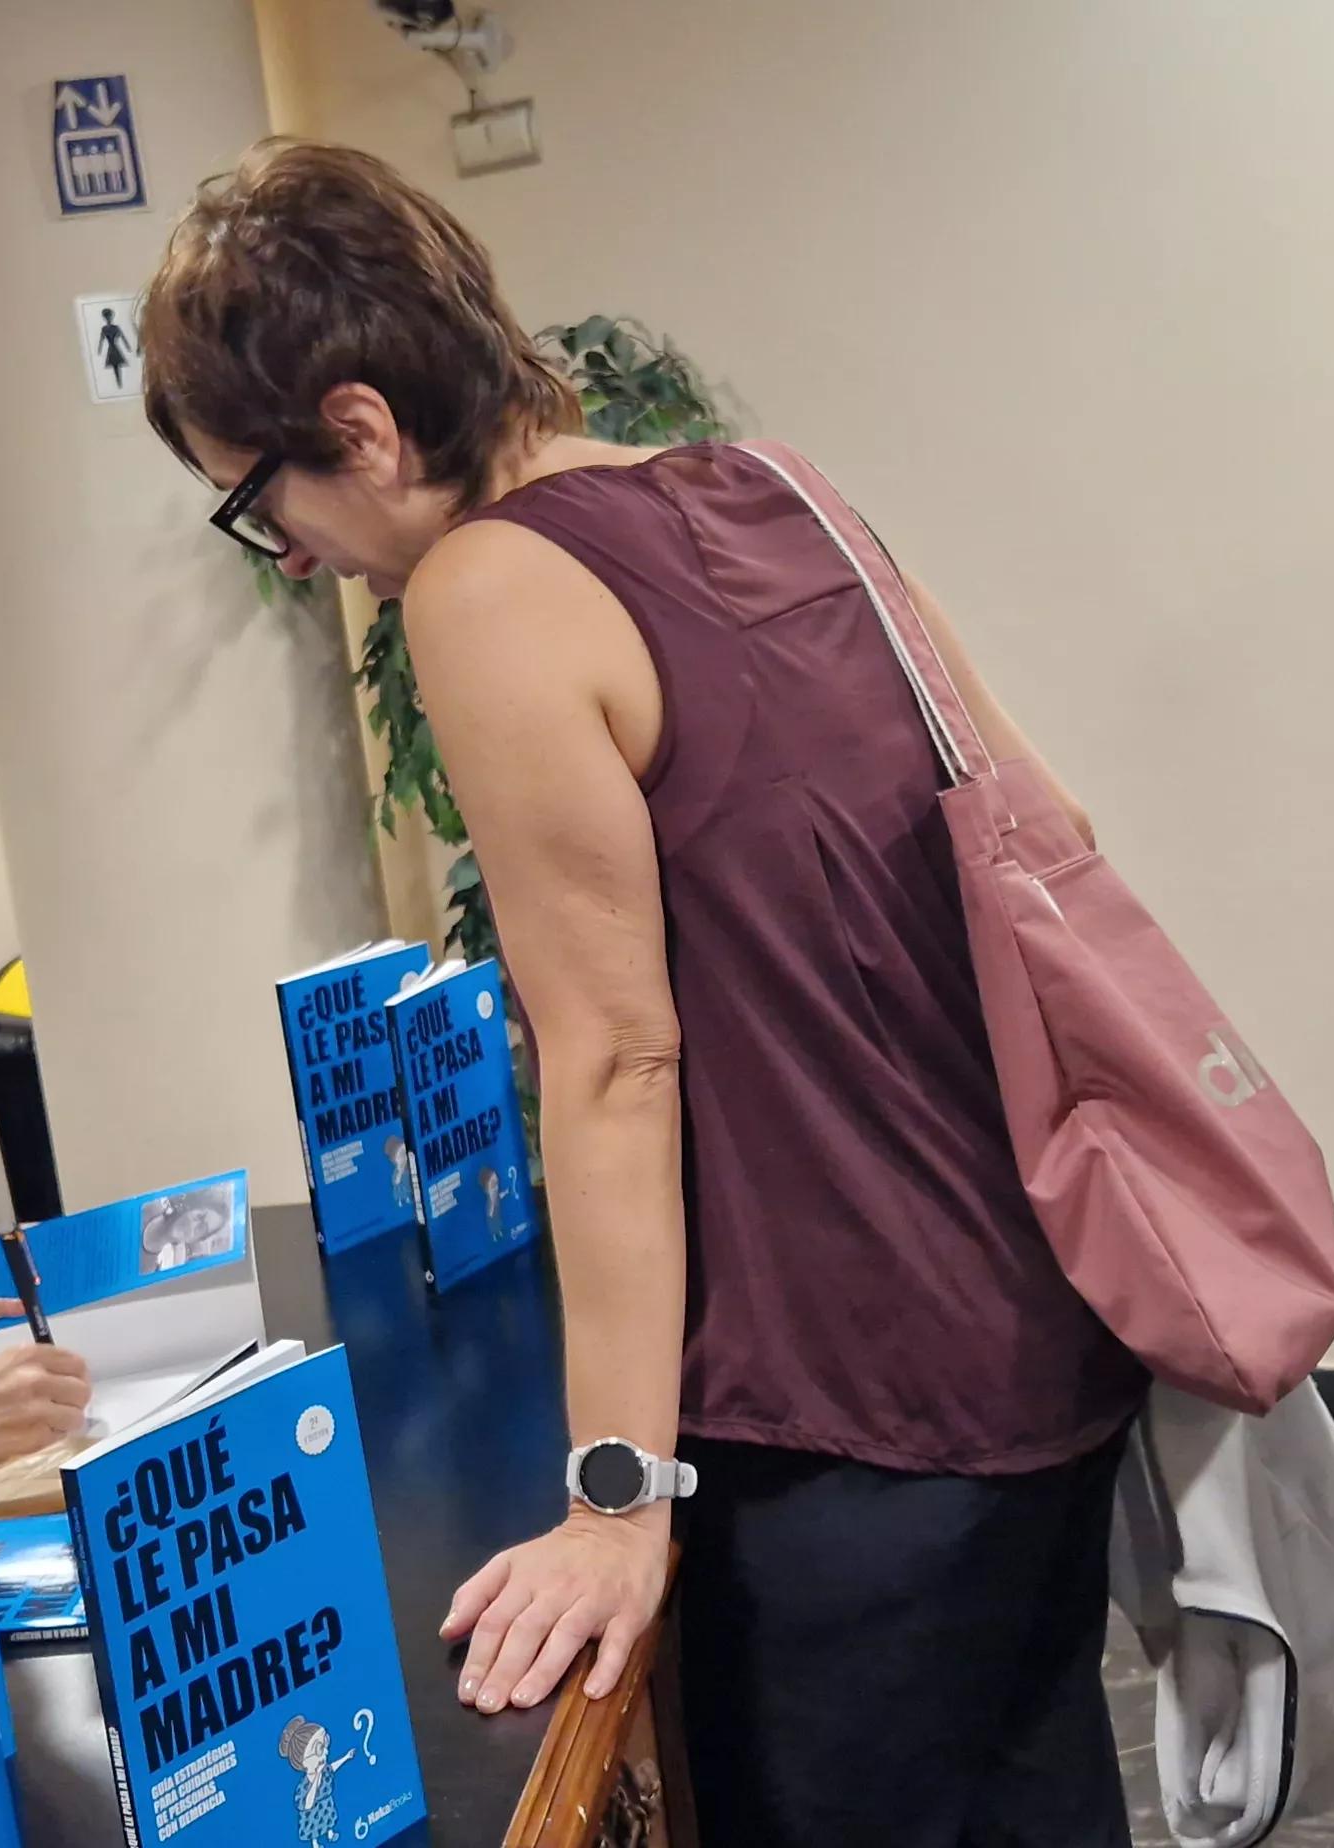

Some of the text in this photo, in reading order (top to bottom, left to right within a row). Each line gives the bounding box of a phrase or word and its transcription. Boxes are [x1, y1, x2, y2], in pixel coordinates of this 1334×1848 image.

[298, 968, 367, 1030] ¿QUÉ
[407, 988, 454, 1055] ¿QUÉ
[302, 1027, 331, 1067] LE
[335, 1010, 389, 1056] PAS
[410, 1052, 432, 1095] LE
[433, 1027, 484, 1082] PASA
[310, 1057, 365, 1108] A MI
[419, 1083, 459, 1138] A MI
[315, 1086, 403, 1147] MADRE
[424, 1105, 502, 1180] MADRE?
[104, 1413, 236, 1553] ¿QUÉ
[113, 1538, 171, 1624] LE
[176, 1472, 307, 1590] PASA
[133, 1583, 239, 1702] A MI
[139, 1606, 343, 1774] MADRE?
[153, 1753, 237, 1815] PARA CUIDADORES
[156, 1780, 216, 1828] DE PERSONAS
[158, 1790, 226, 1842] CON DEMENCIA
